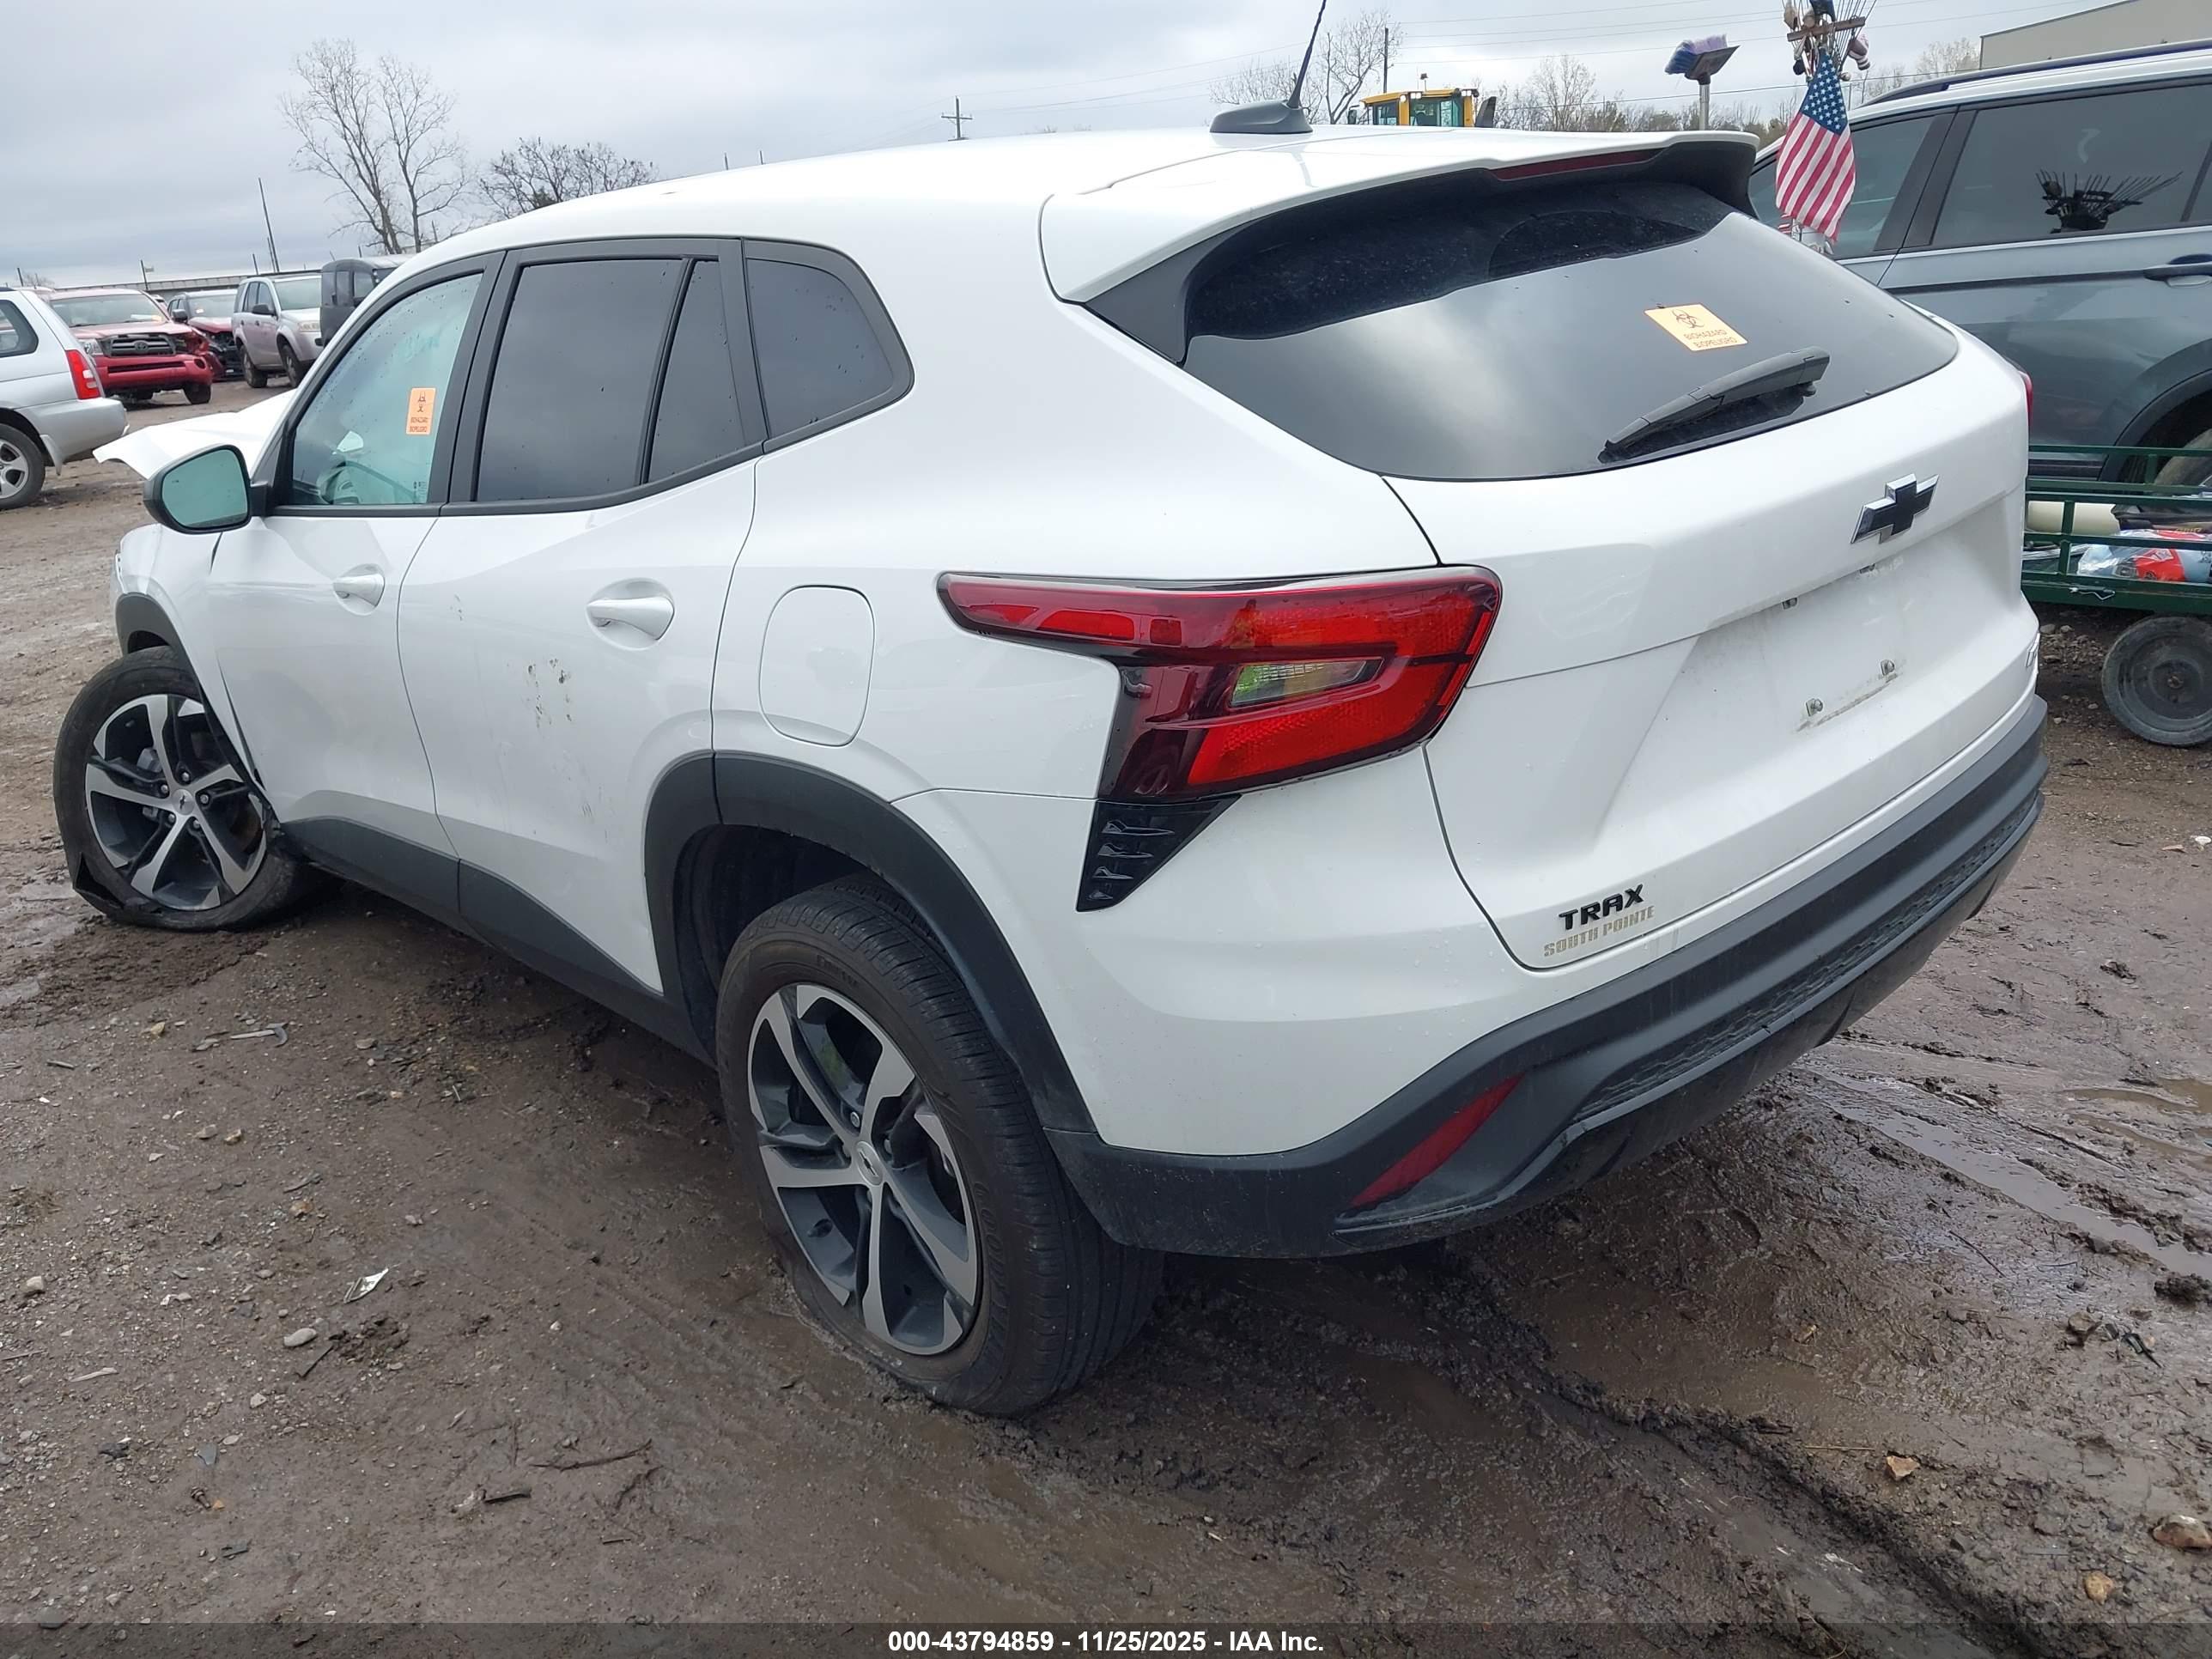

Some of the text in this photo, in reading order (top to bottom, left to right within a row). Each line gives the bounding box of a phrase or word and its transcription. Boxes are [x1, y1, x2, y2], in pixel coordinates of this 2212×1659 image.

[1684, 329, 1727, 339] BIOHAZARD
[1693, 337, 1737, 348] BIOPELIGRO
[1558, 883, 1644, 931] TRAX
[1543, 905, 1655, 957] SOUTH POINTE
